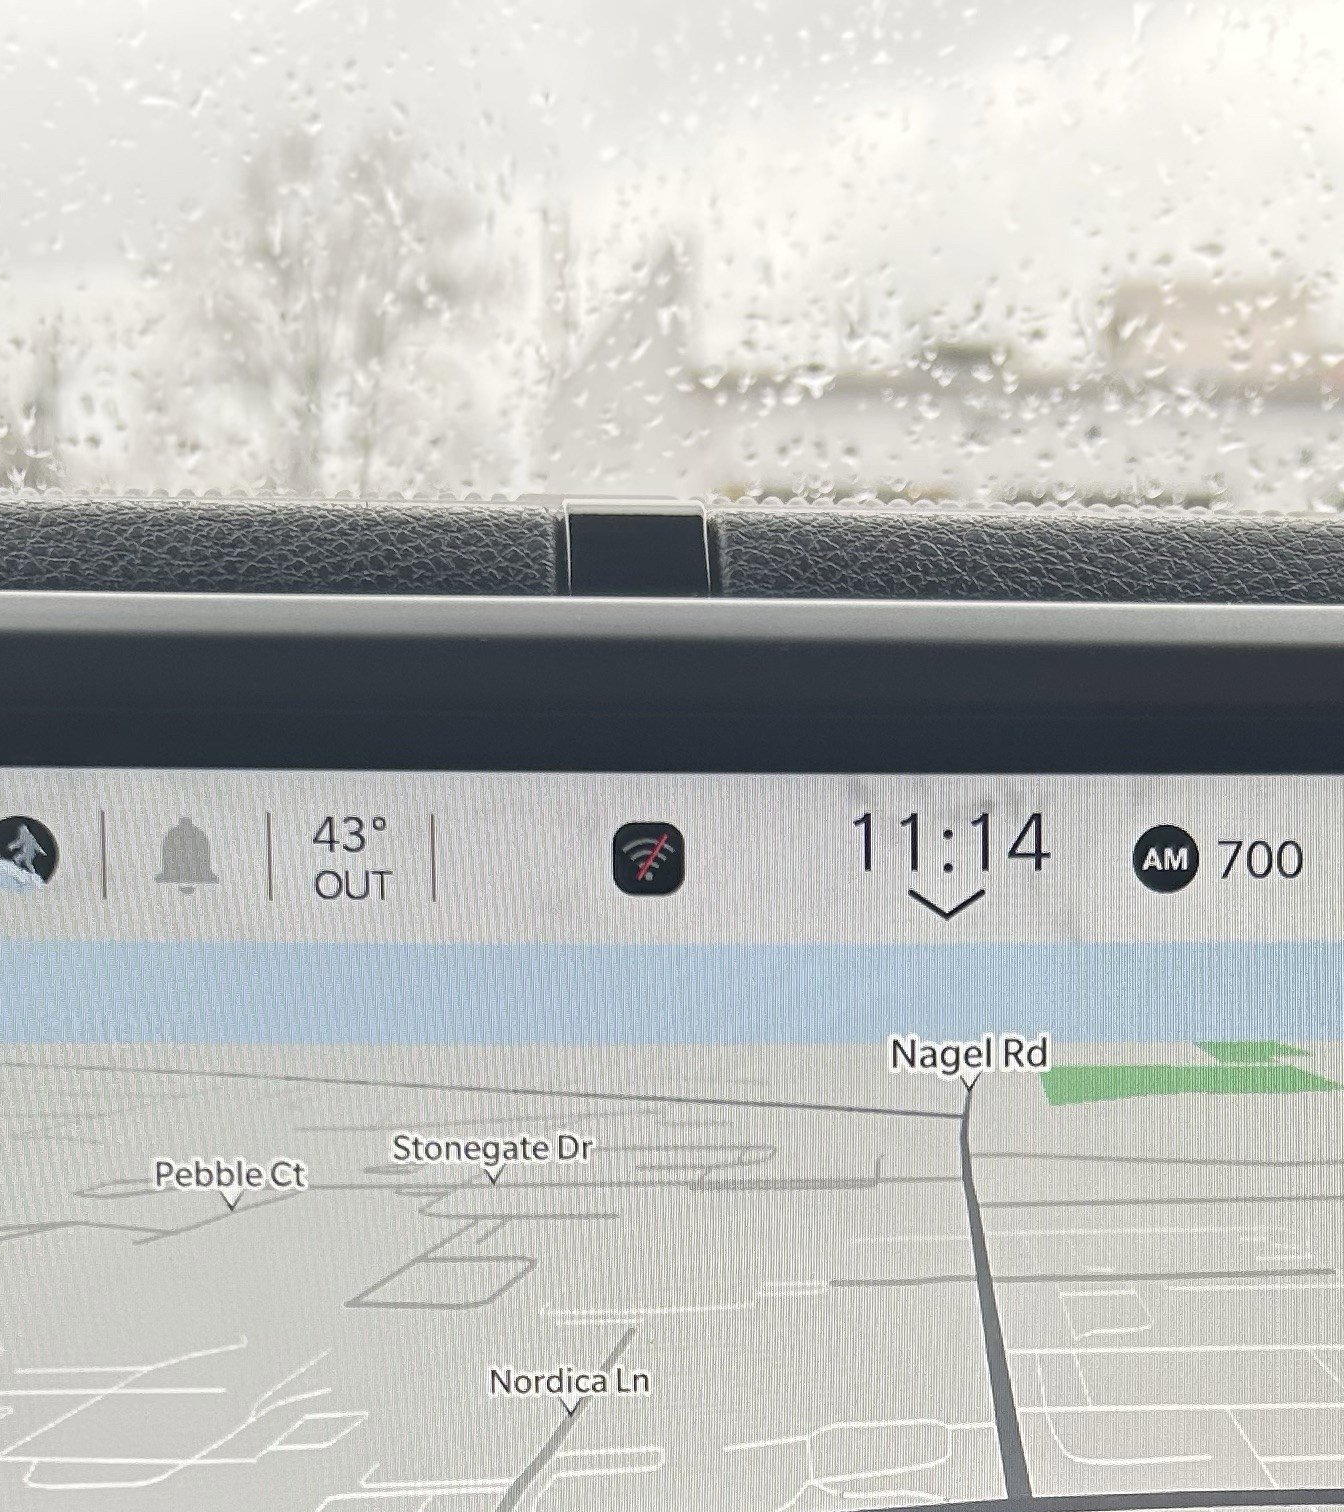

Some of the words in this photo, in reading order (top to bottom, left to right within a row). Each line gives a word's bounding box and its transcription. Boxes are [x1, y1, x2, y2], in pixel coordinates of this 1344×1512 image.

[853, 812, 1051, 873] 11:14
[1142, 847, 1189, 871] AM
[1217, 840, 1304, 879] 700
[314, 869, 393, 901] OUT
[892, 1037, 992, 1074] Nagel
[1004, 1037, 1047, 1068] Rd
[393, 1134, 549, 1167] Stonegate
[558, 1134, 593, 1160] Dr
[156, 1160, 263, 1187] Pebble
[270, 1160, 304, 1187] Ct
[490, 1367, 607, 1394] Nordica
[616, 1368, 649, 1393] Ln
